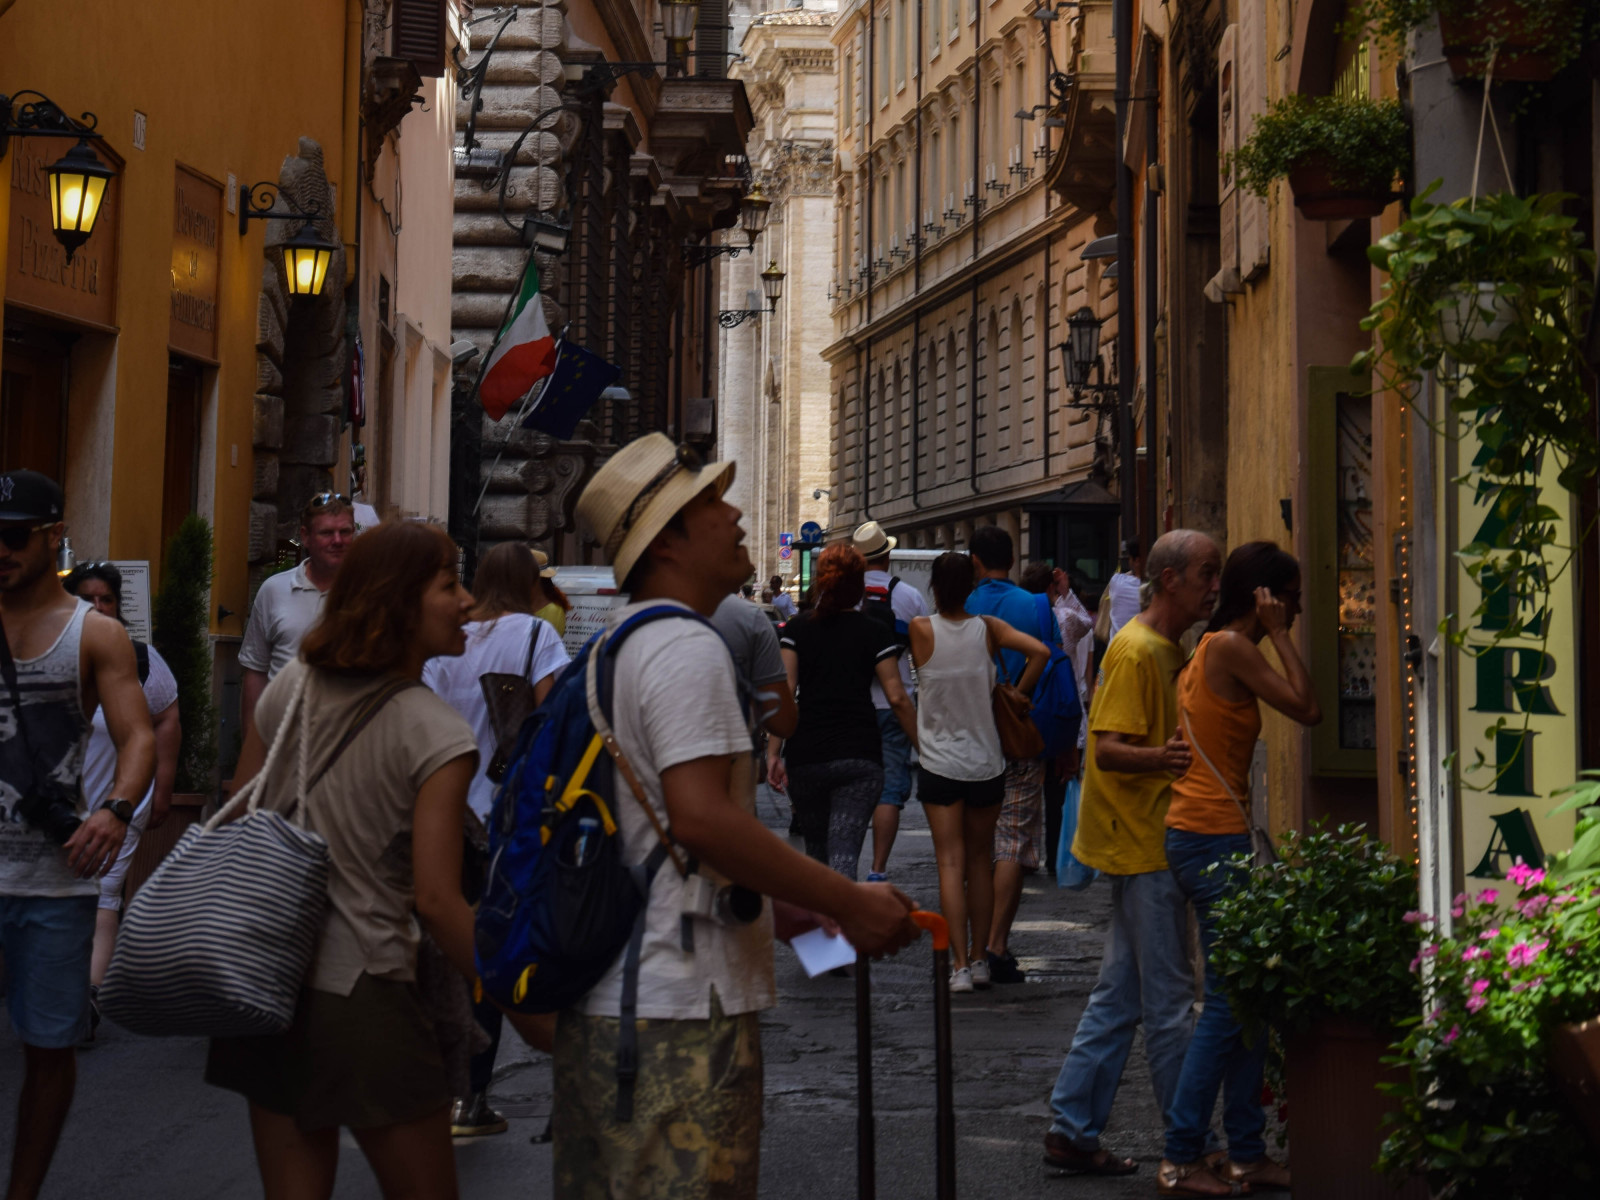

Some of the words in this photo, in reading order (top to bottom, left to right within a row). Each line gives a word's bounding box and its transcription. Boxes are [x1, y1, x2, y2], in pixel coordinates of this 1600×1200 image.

[18, 214, 98, 296] Pizzeria
[899, 561, 934, 572] PIAG
[1466, 402, 1566, 879] ZZERIA
